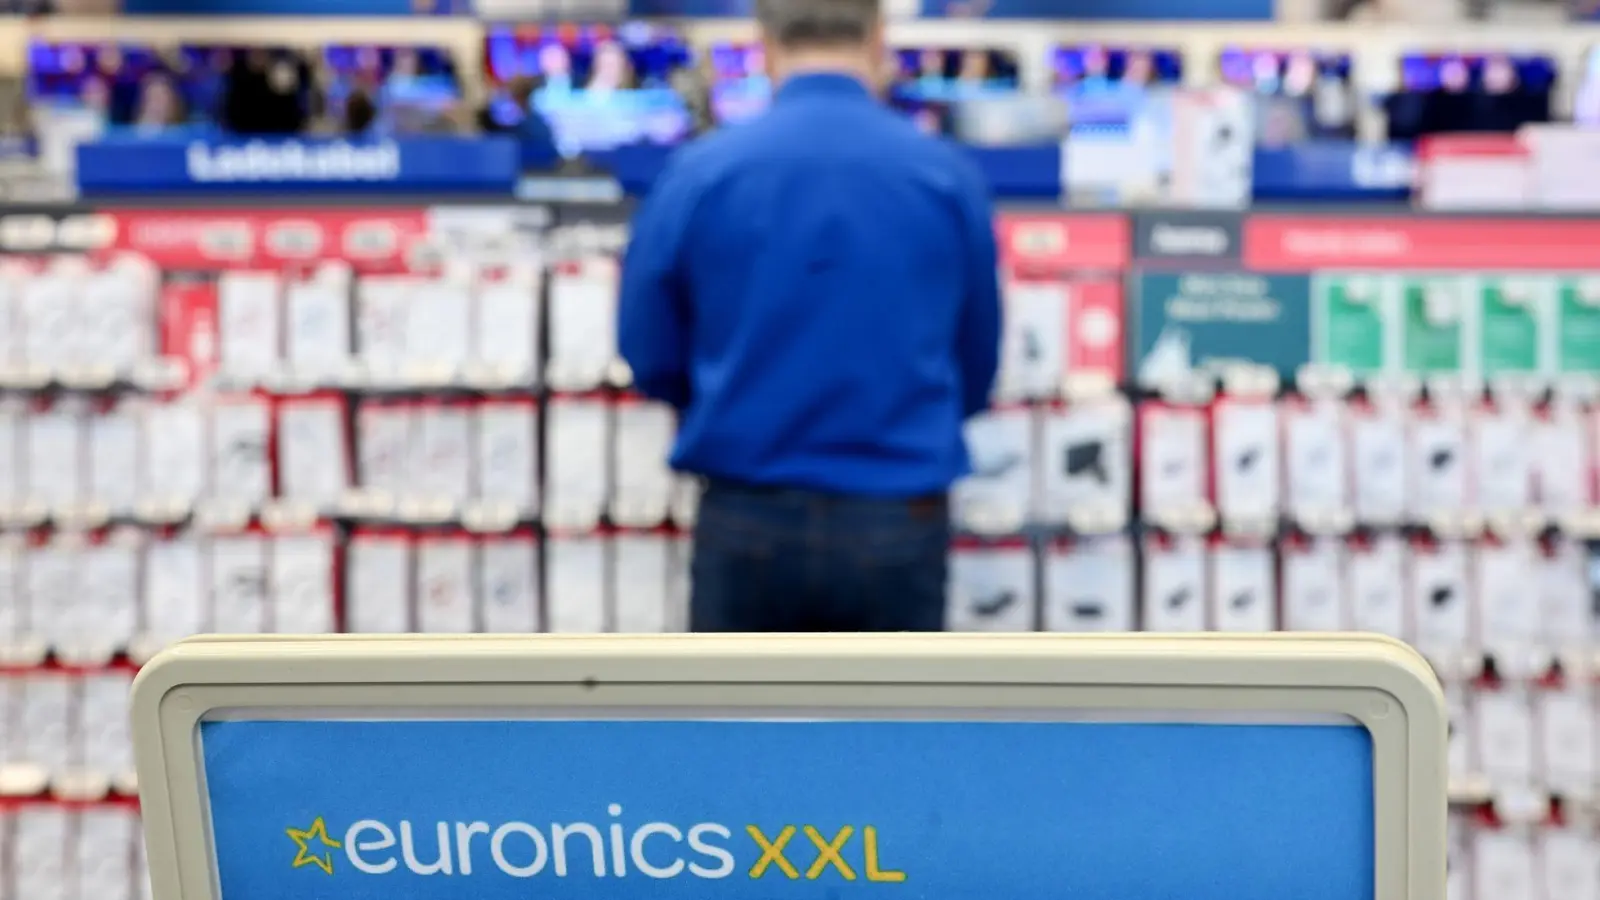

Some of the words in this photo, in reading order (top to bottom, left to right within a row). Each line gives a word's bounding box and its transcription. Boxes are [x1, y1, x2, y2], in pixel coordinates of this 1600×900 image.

[187, 140, 400, 182] Ladekabel
[344, 803, 735, 880] euronics
[745, 824, 907, 883] XXL
